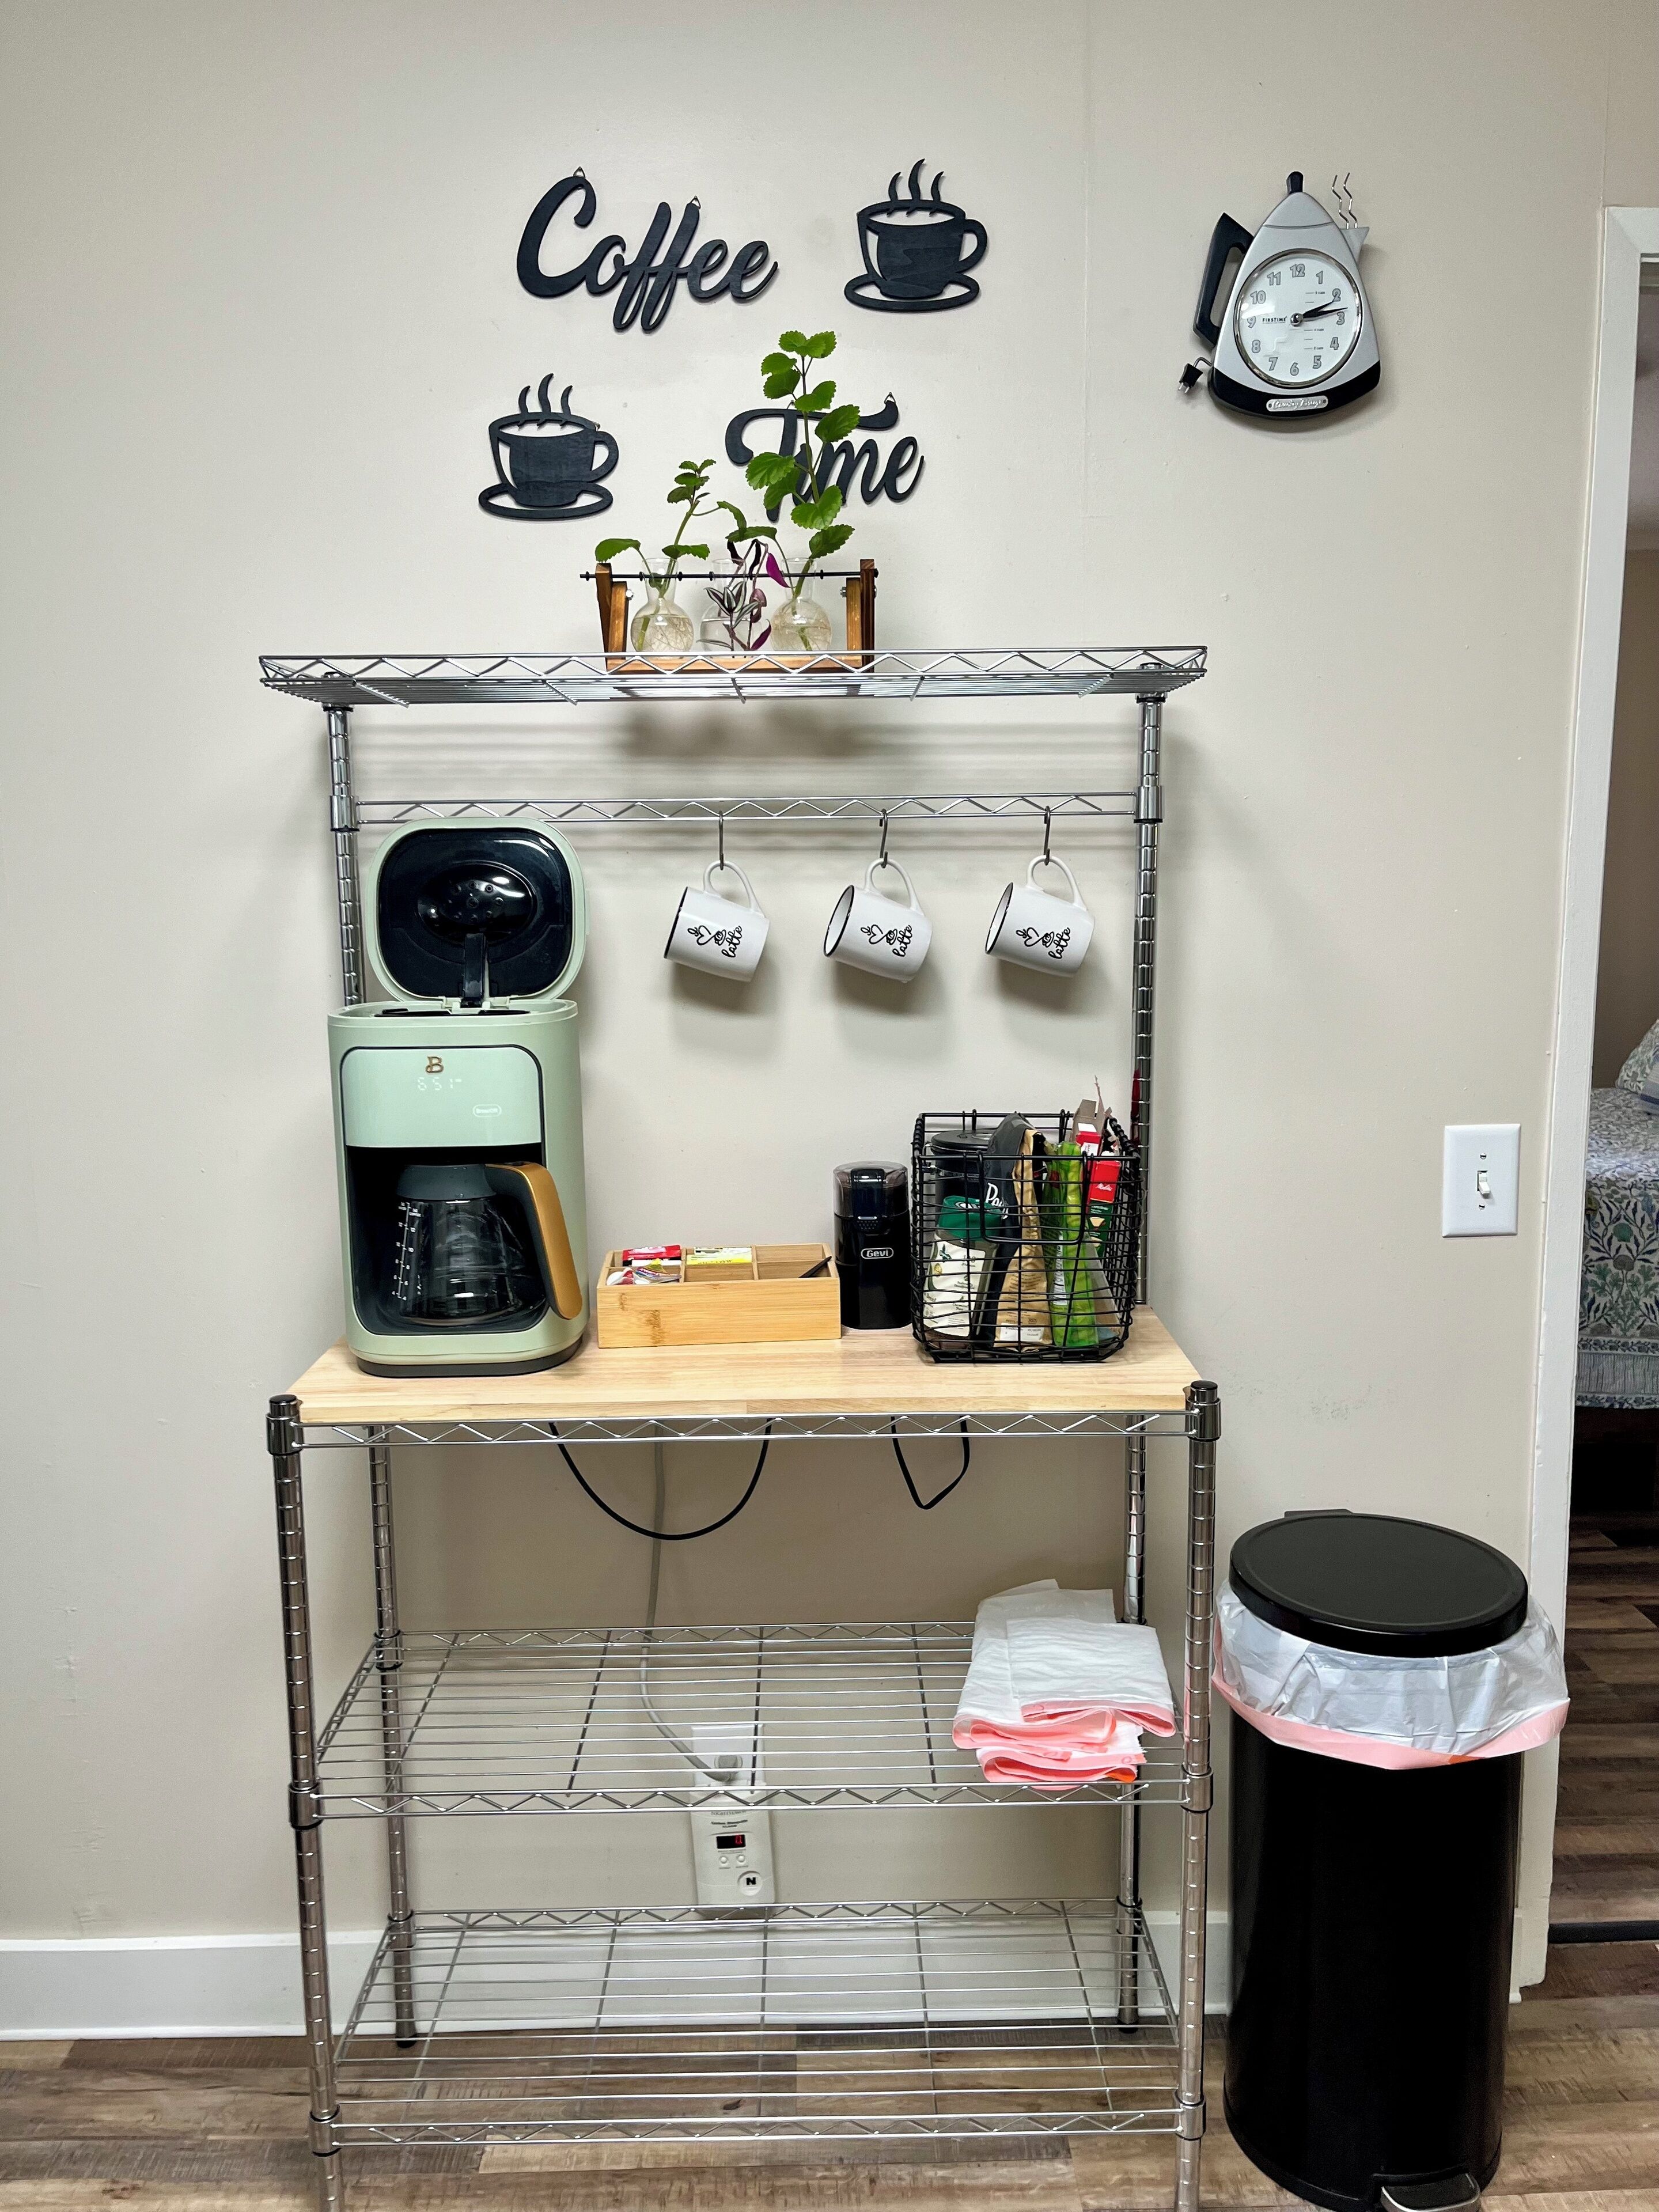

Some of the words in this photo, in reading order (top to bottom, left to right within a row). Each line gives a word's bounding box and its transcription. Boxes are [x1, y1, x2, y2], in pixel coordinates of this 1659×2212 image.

[517, 175, 778, 332] Coffee
[1290, 263, 1305, 277] 12
[1267, 271, 1281, 286] 11
[1316, 271, 1324, 285] 1
[1250, 290, 1266, 305] 10
[1332, 288, 1342, 302] 2
[1247, 316, 1256, 328] 9
[1336, 312, 1345, 325] 3
[1251, 339, 1261, 353] 8
[1330, 336, 1339, 350] 4
[1268, 357, 1278, 371] 7
[1290, 362, 1299, 376] 6
[1312, 355, 1322, 369] 5
[725, 400, 925, 522] Time
[721, 926, 743, 958] latte
[892, 925, 912, 957] latte
[1048, 927, 1071, 959] latte
[866, 1249, 889, 1257] Gevi
[746, 1877, 757, 1885] N
